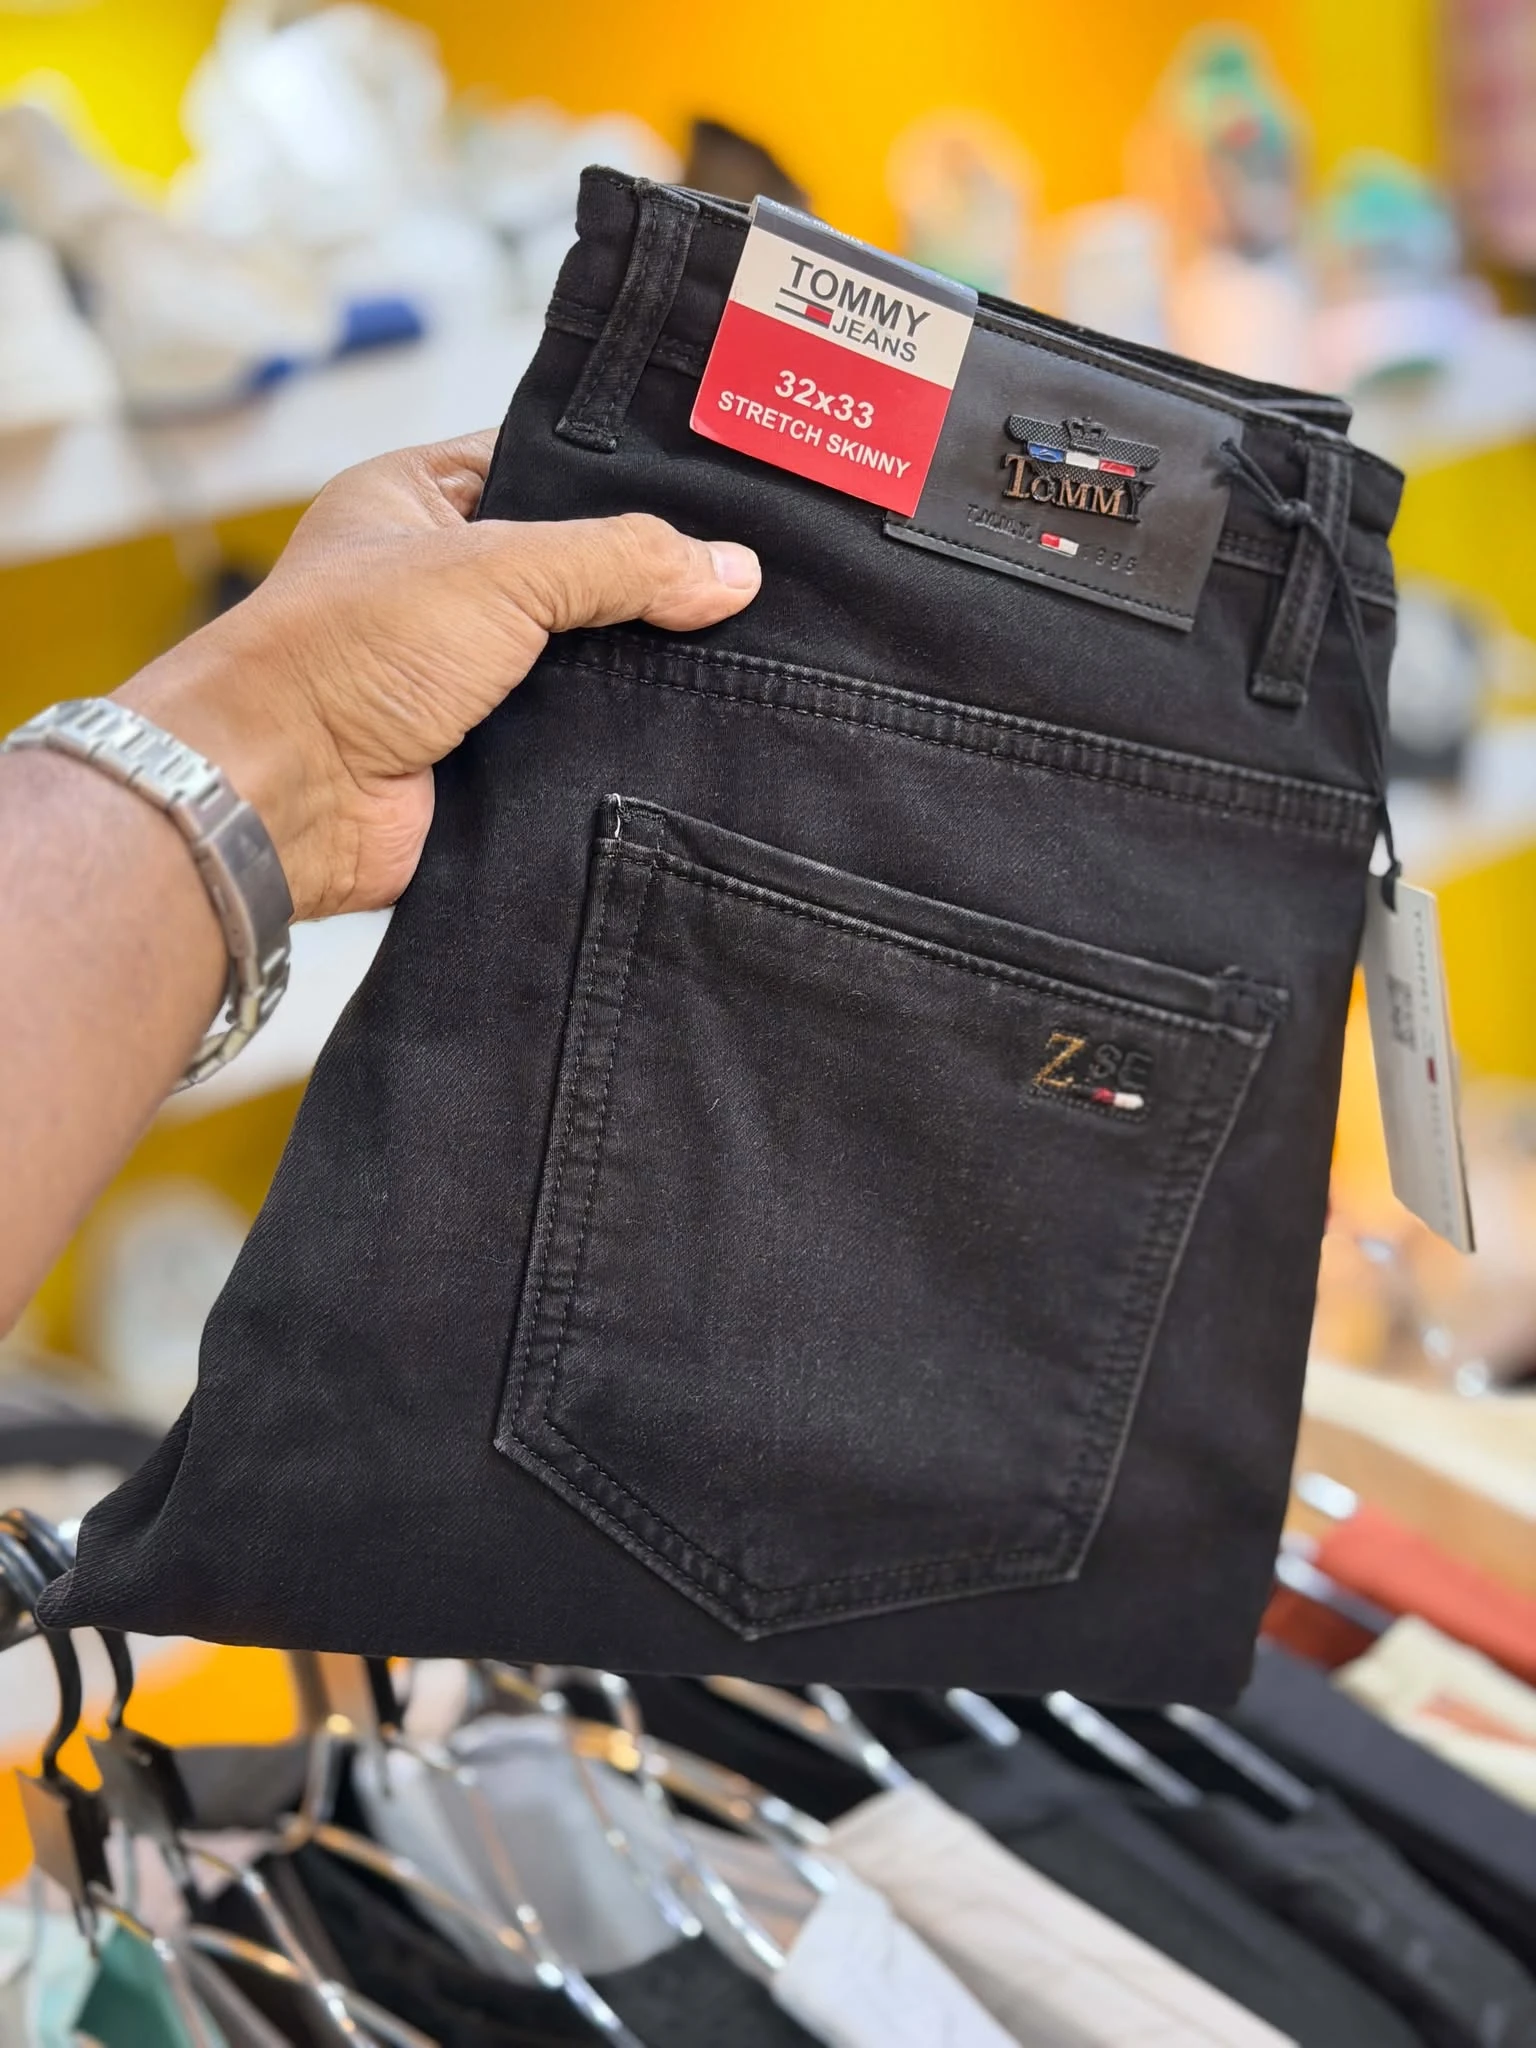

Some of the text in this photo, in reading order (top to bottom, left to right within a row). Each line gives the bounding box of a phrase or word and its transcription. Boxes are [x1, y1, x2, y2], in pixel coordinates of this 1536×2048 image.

[790, 255, 931, 338] TOMMY
[832, 315, 918, 363] JEANS
[717, 390, 911, 479] STRETCH SKINNY
[774, 369, 875, 430] 32x33
